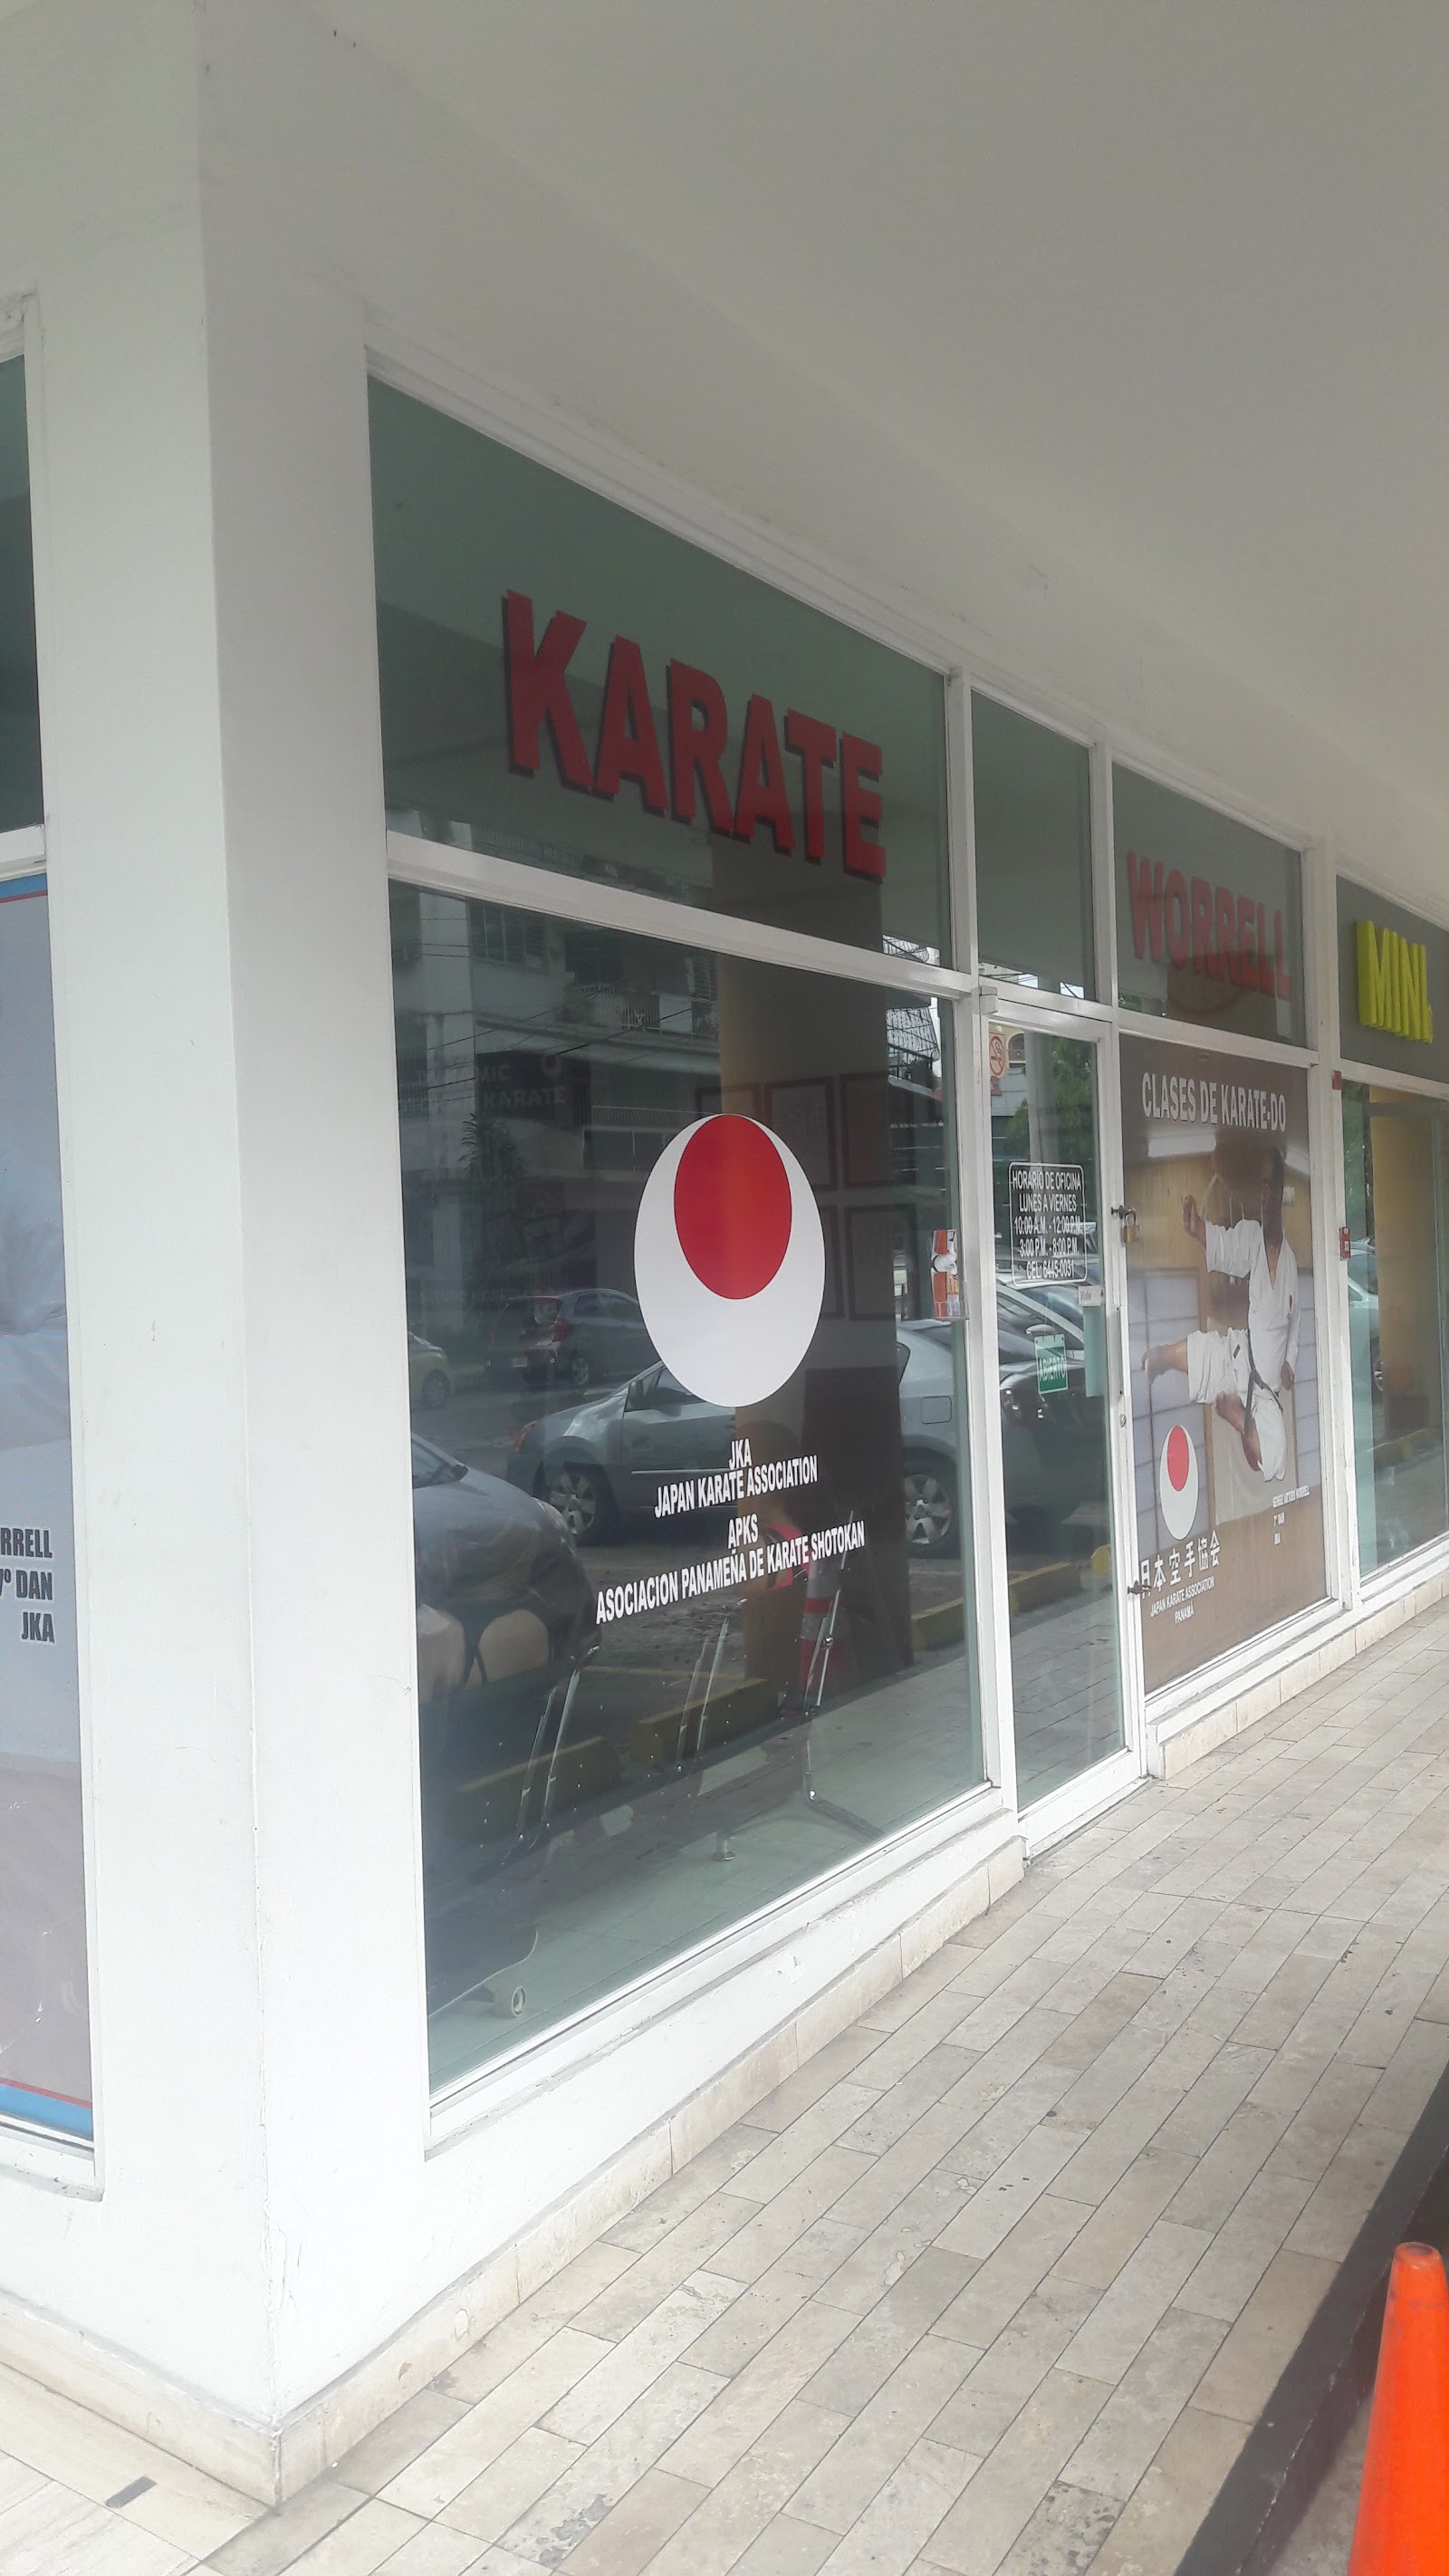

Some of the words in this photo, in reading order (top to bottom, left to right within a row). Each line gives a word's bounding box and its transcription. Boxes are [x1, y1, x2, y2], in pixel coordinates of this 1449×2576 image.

[503, 589, 887, 884] KARATE
[1127, 849, 1293, 1002] WORRELL
[1142, 1072, 1196, 1122] CLASES
[1200, 1080, 1218, 1125] DE
[1221, 1084, 1287, 1132] KARATE-DO
[1012, 1170, 1044, 1190] HORARIO
[1045, 1171, 1055, 1190] DE
[1055, 1172, 1082, 1191] OFICINA
[1019, 1193, 1042, 1213] LUNES
[1042, 1194, 1049, 1213] A
[1049, 1194, 1077, 1213] VIERNES
[1014, 1215, 1033, 1235] 10:00
[1033, 1216, 1048, 1235] A.M.
[1052, 1215, 1070, 1234] 12:00
[1019, 1238, 1033, 1257] 3:00
[1034, 1237, 1048, 1257] P.M.
[1052, 1237, 1067, 1256] 8:00
[1067, 1236, 1080, 1255] P.M.
[1026, 1260, 1042, 1280] CEL:
[1039, 1355, 1066, 1382] ABIERTO
[728, 1437, 752, 1470] JKA
[654, 1479, 696, 1518] JAPAN
[697, 1469, 744, 1508] KARATE
[746, 1454, 818, 1497] ASSOCIATION
[727, 1513, 759, 1550] APKS
[15, 1570, 53, 1600] DAN
[595, 1571, 678, 1625] ASOCIACION
[682, 1549, 747, 1600] PANAMEÑA
[749, 1547, 764, 1580] DE
[766, 1538, 809, 1574] KARATE
[811, 1520, 866, 1561] SHOTOKAN
[1149, 1596, 1166, 1618] JAPAN
[1166, 1588, 1185, 1610] KARATE
[1185, 1575, 1215, 1600] ASSOCIATION
[21, 1611, 54, 1644] JKA
